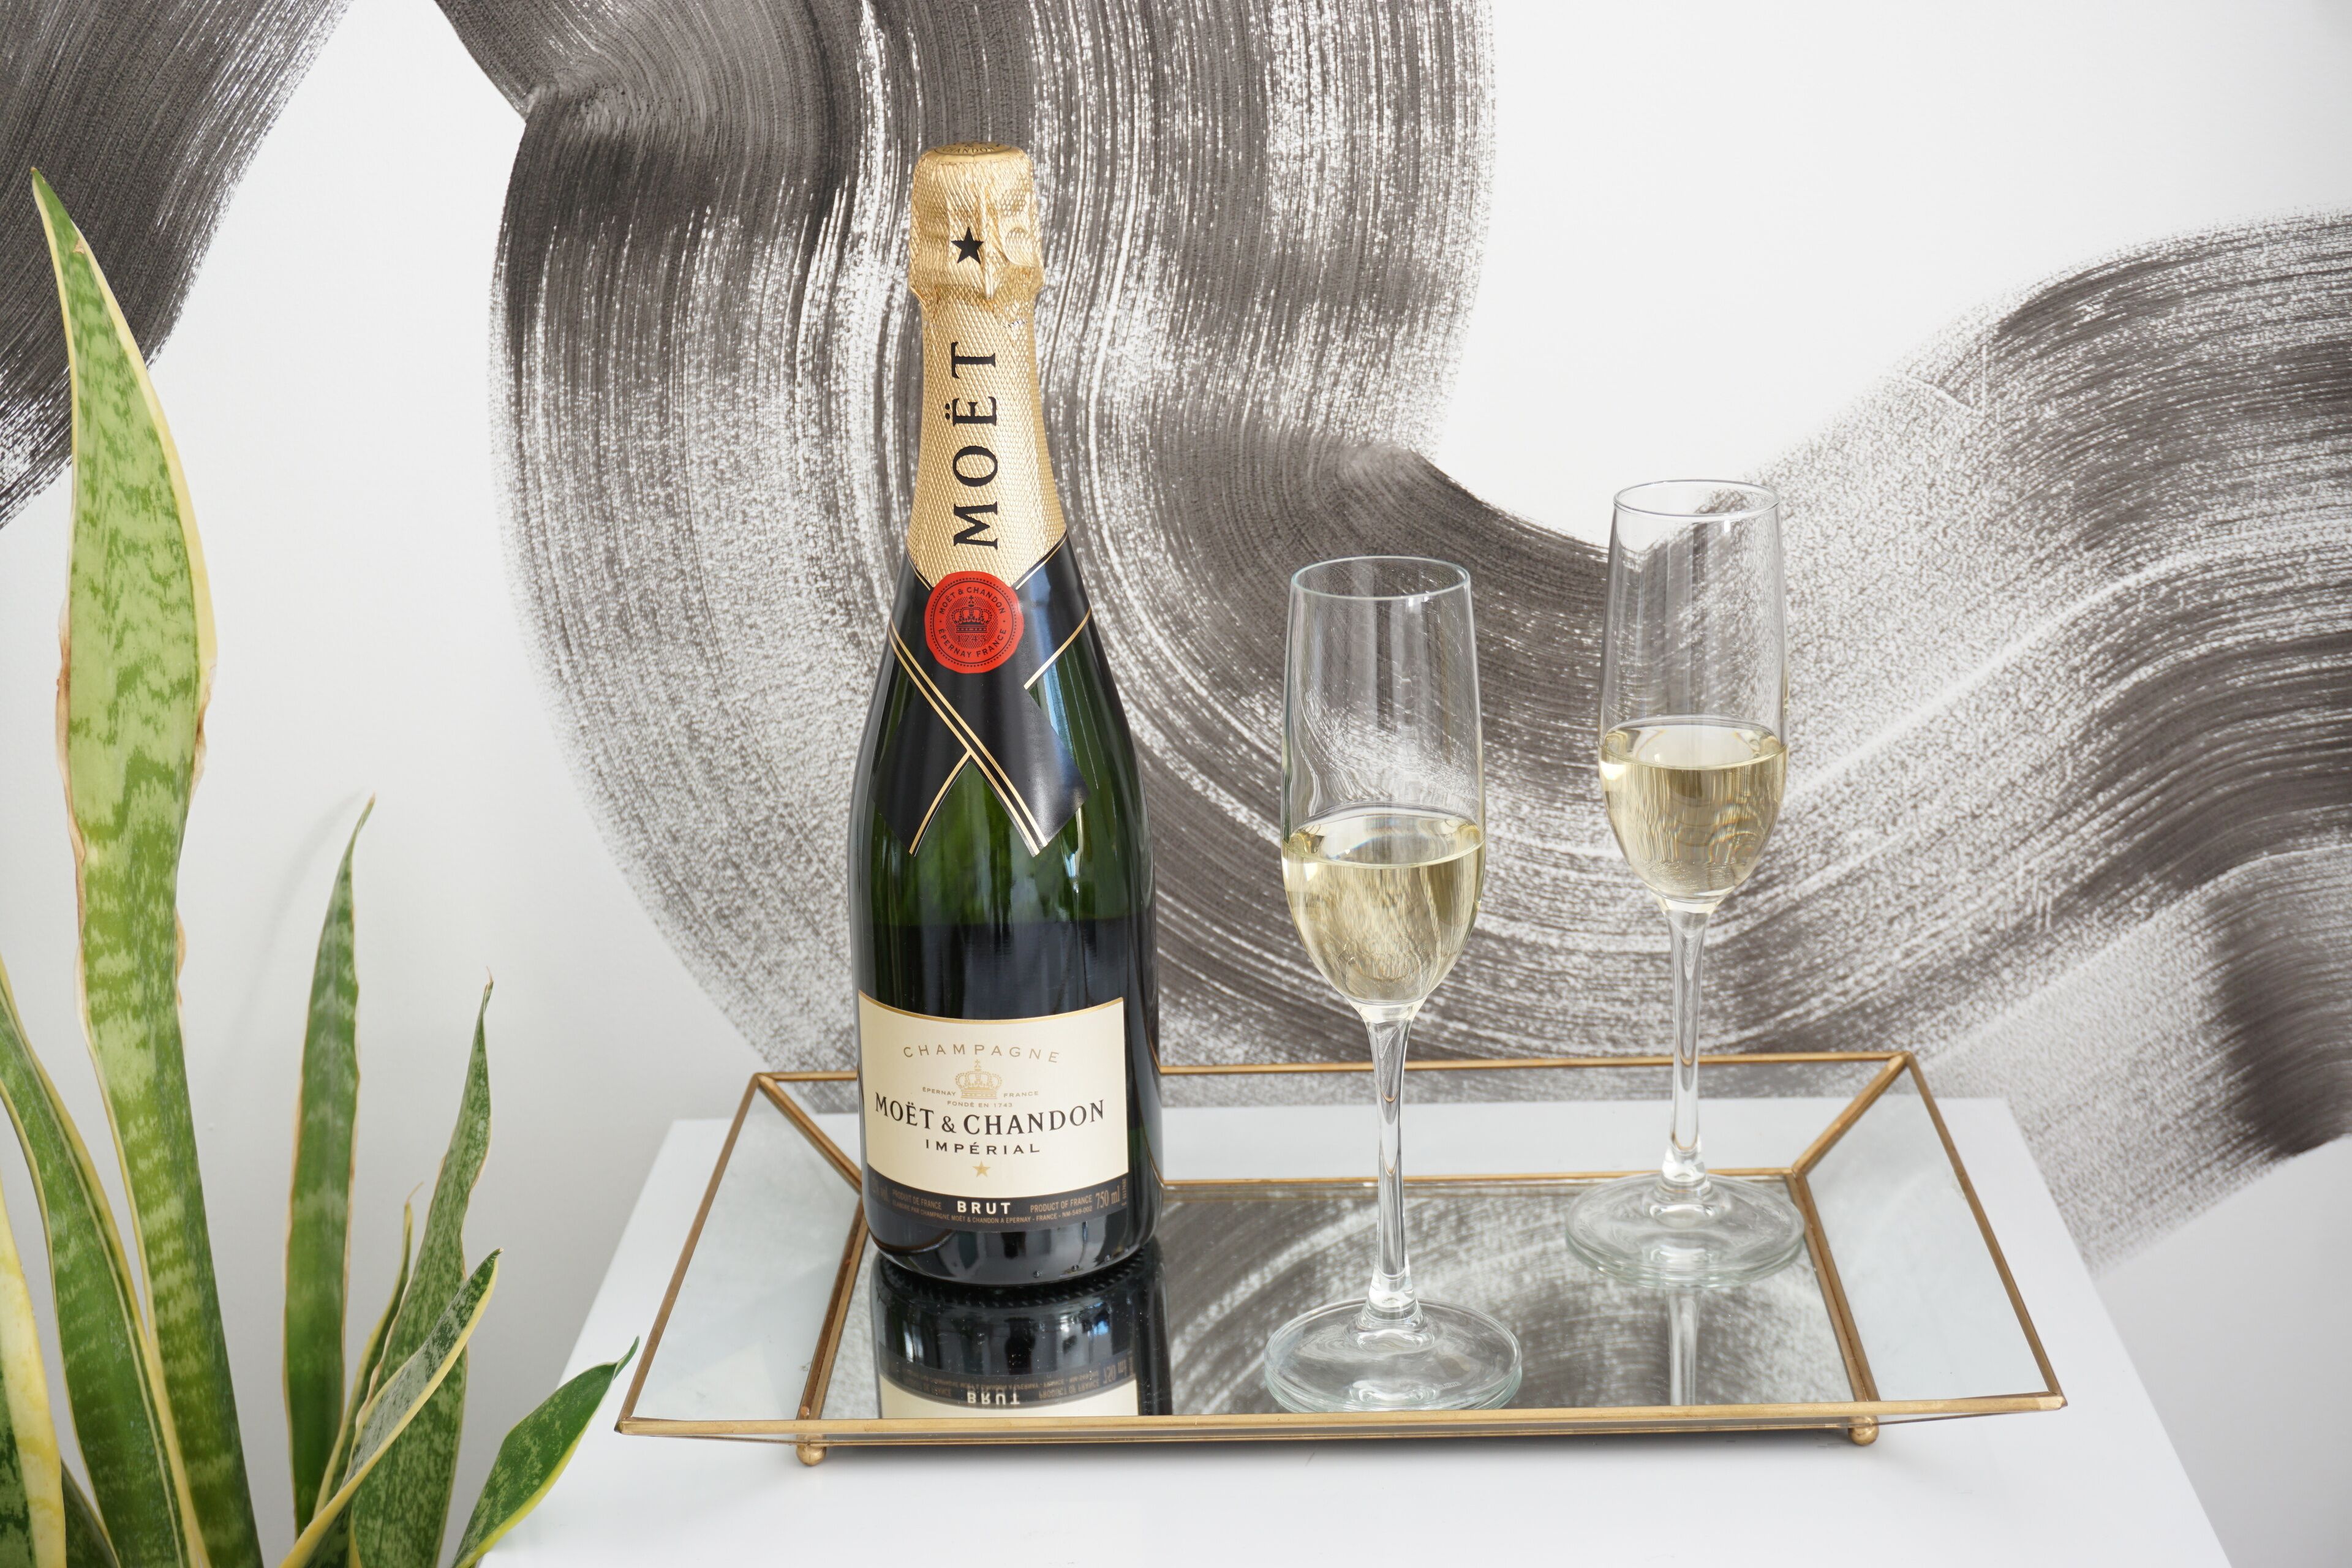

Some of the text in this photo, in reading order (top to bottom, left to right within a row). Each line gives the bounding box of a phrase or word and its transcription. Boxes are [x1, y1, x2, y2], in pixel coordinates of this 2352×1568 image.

[945, 342, 998, 550] MOËT
[939, 592, 956, 614] MOËT
[966, 587, 1006, 614] CHANDON
[938, 628, 1006, 658] ÉPERNAY FRANCE
[903, 1044, 1059, 1063] CHAMPAGNE
[922, 1087, 956, 1096] ÉPERNAY
[875, 1091, 1104, 1135] MOËT & CHANDON
[925, 1139, 1040, 1155] IMPÉRIAL
[913, 1196, 920, 1206] DE
[921, 1199, 942, 1210] FRANCE
[1030, 1195, 1093, 1213] PRODUCT OF FRANCE
[1096, 1189, 1109, 1209] 750
[1111, 1185, 1120, 1204] ml
[921, 1209, 950, 1221] CHAMPAGNE
[957, 1200, 1011, 1215] BRUT
